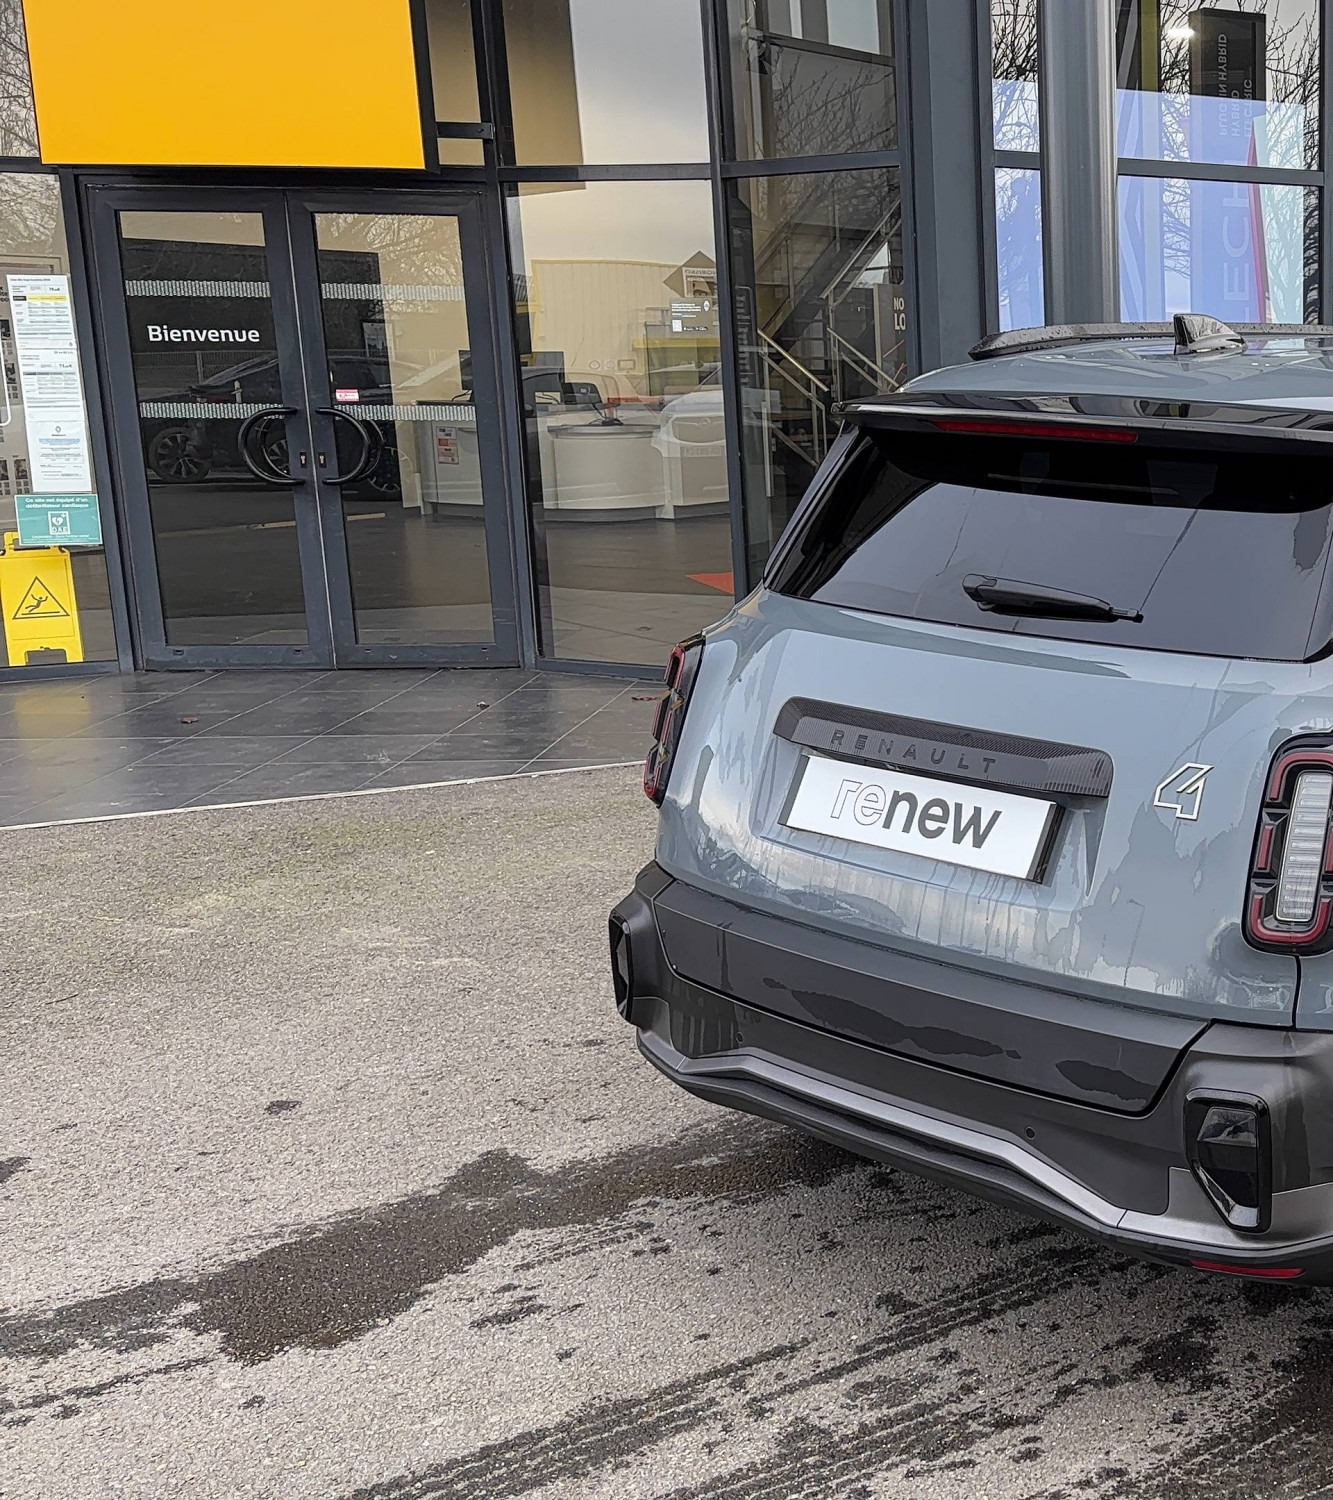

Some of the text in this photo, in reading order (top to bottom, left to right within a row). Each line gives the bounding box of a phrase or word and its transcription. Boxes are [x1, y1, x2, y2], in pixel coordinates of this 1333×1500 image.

[147, 325, 260, 342] Bienvenue
[830, 729, 996, 774] RENAULT
[829, 778, 1002, 848] renew
